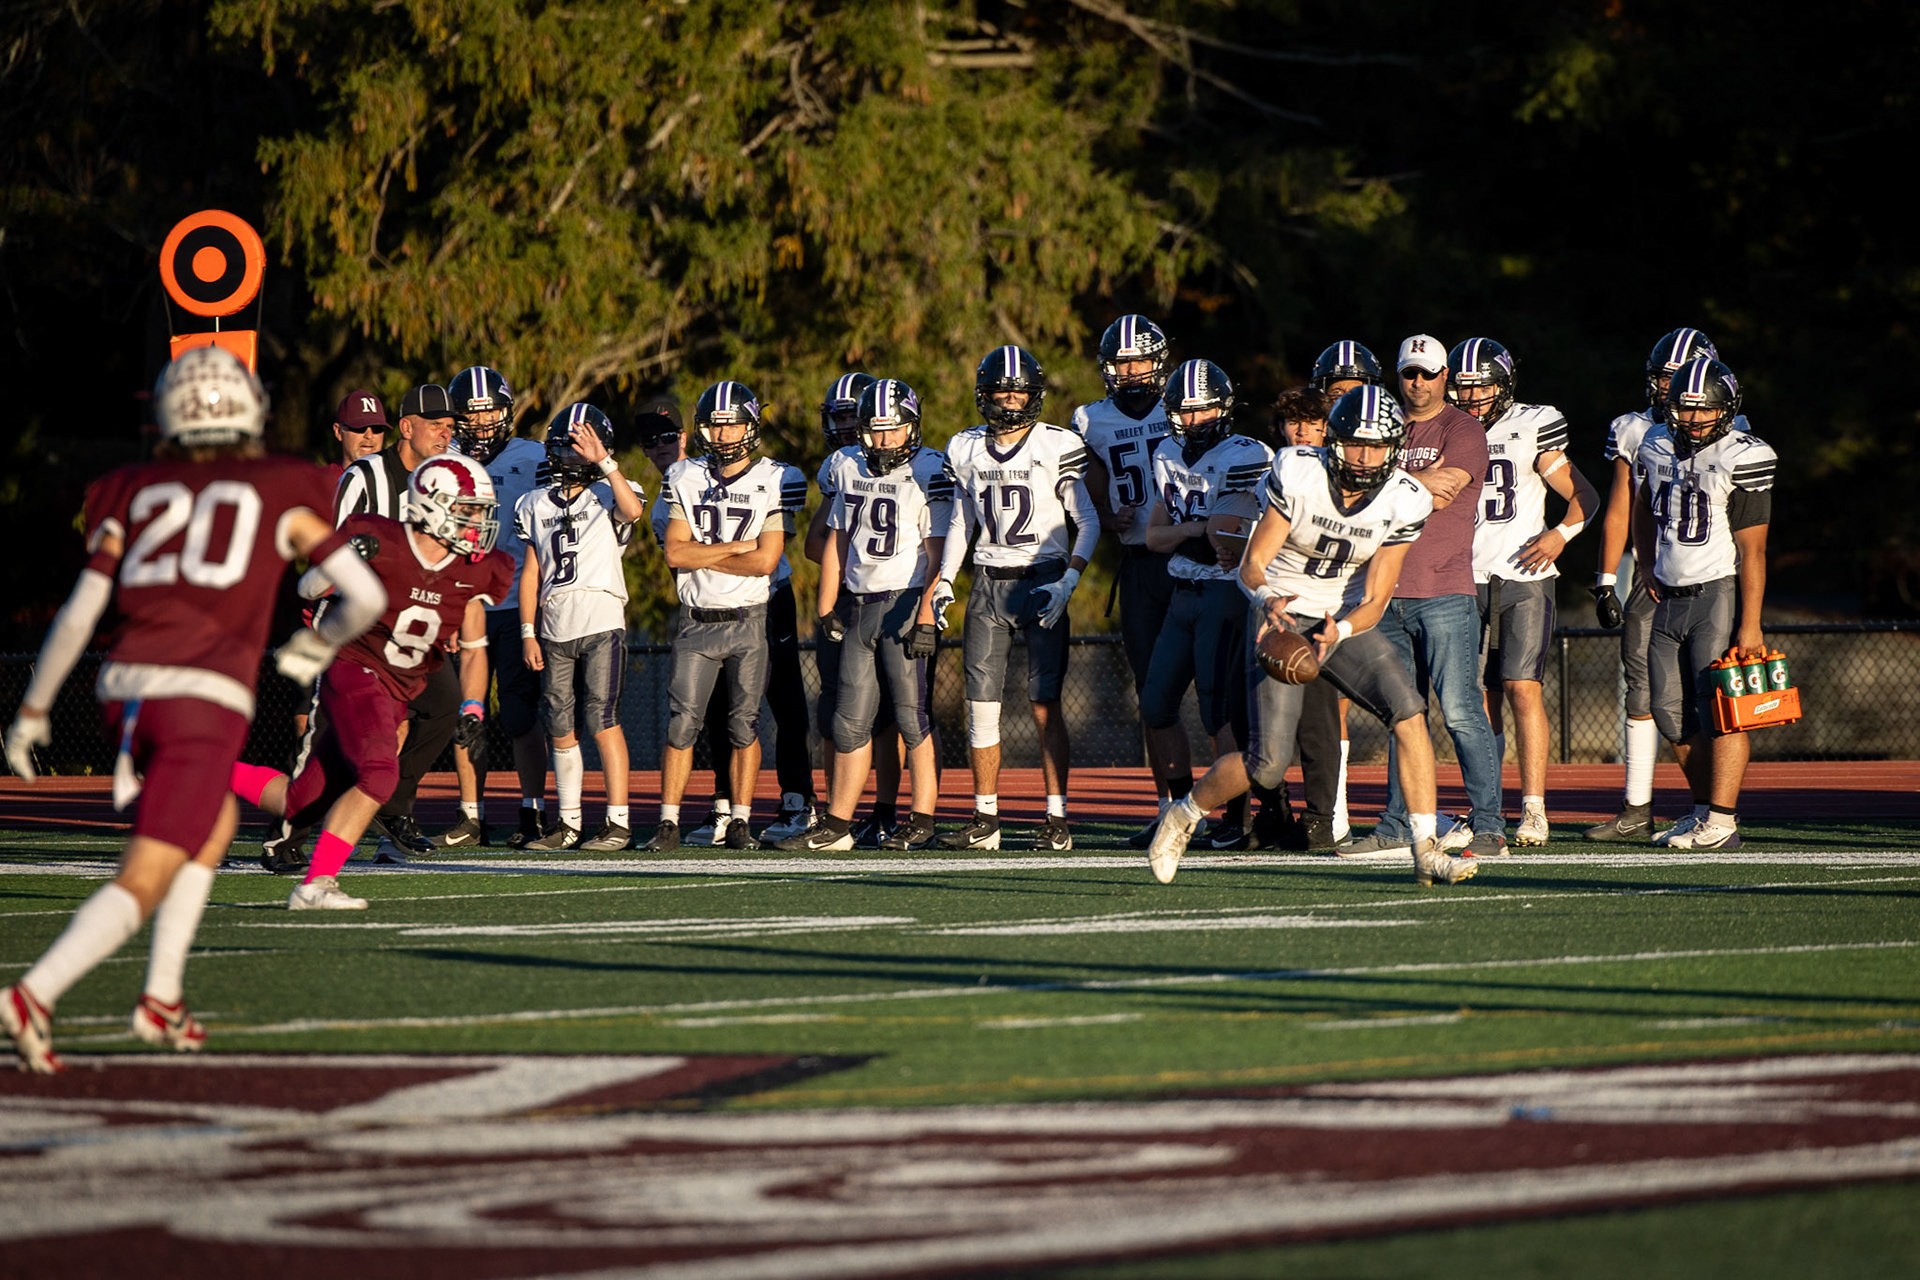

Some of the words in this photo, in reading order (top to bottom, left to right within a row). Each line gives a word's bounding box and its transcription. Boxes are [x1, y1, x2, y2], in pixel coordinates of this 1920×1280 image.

[360, 397, 378, 413] N
[1114, 424, 1144, 440] VALLEY
[1148, 421, 1170, 434] TECH
[1488, 444, 1506, 454] ECH
[978, 469, 1005, 481] VALLEY
[1009, 469, 1030, 481] TECH
[852, 479, 875, 492] VALLEY
[879, 483, 897, 495] TECH
[1475, 458, 1518, 525] 3
[729, 493, 751, 504] TECH
[979, 484, 1040, 548] 12
[119, 480, 264, 591] 20
[844, 493, 900, 560] 79
[1312, 514, 1346, 535] VALLEY
[1349, 526, 1373, 540] TECH
[550, 526, 580, 588] 6
[409, 587, 442, 605] RAMS
[383, 604, 443, 670] 8
[1730, 676, 1744, 692] G
[1771, 668, 1786, 684] G
